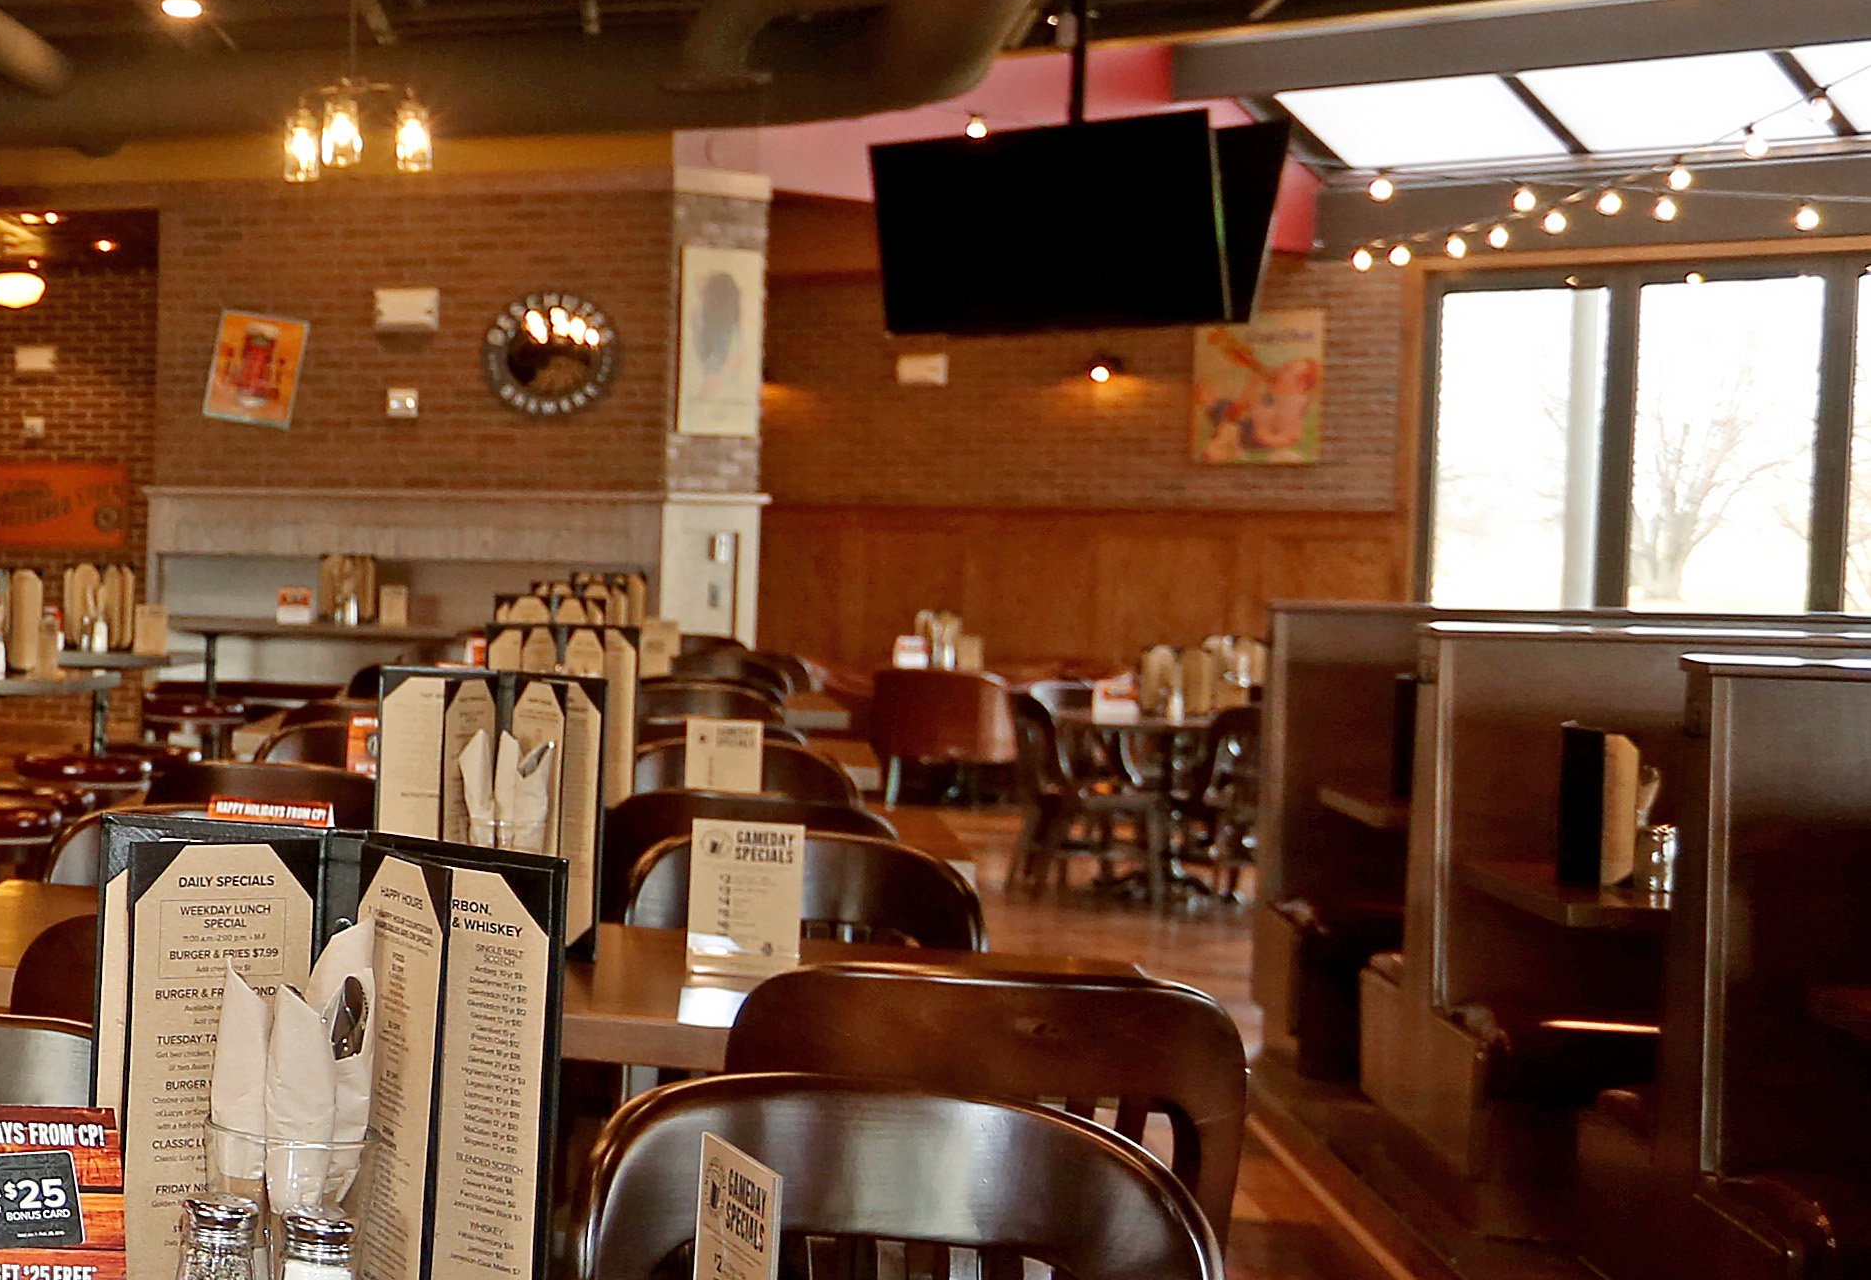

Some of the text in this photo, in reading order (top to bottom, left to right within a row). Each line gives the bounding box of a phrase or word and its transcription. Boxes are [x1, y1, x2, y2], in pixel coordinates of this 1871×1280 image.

[735, 829, 796, 849] GAMEDAY
[734, 846, 794, 864] SPECIALS
[178, 875, 275, 888] DAILY SPECIALS
[380, 885, 424, 911] HAPPY HOURS
[180, 904, 271, 916] WEEKDAY LUNCH
[203, 918, 247, 929] SPECIAL
[452, 917, 524, 938] & WHISKEY
[169, 948, 279, 960] BURGER & FRIES $7.99
[475, 943, 524, 959] SINGLE MALT
[483, 954, 515, 967] SCOTCH
[155, 988, 199, 1000] BURGER
[200, 988, 208, 998] &
[157, 1034, 204, 1045] TUESDAY
[165, 1080, 206, 1091] BURGER
[26, 1122, 77, 1146] FROM
[77, 1123, 106, 1147] CP!
[152, 1139, 194, 1150] CLASSIC
[456, 1151, 524, 1175] BLENDED SCOTCH
[3, 1178, 67, 1210] $25
[156, 1184, 190, 1195] FRIDAY
[727, 1168, 768, 1220] GAMEDAY
[5, 1208, 71, 1222] BONUS CARD
[469, 1221, 505, 1236] WHISKEY
[725, 1200, 765, 1254] SPECIALS
